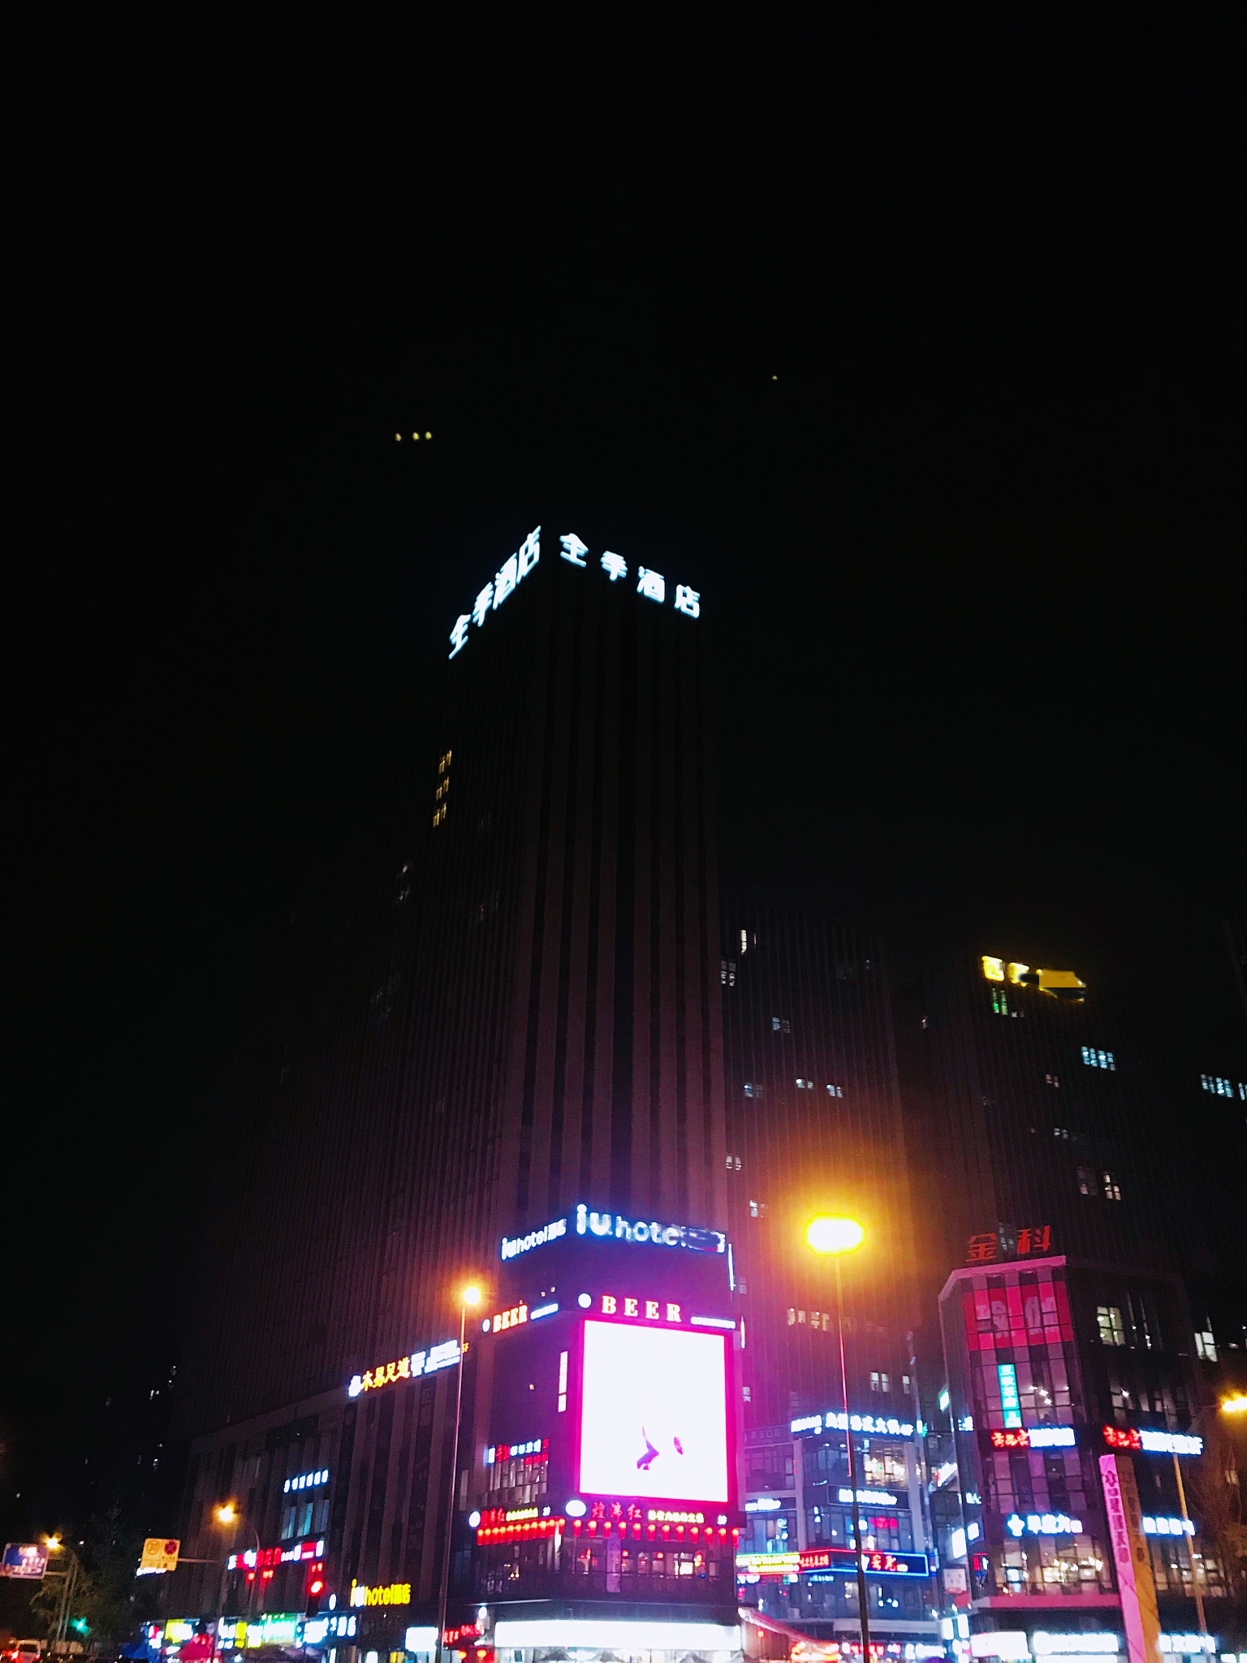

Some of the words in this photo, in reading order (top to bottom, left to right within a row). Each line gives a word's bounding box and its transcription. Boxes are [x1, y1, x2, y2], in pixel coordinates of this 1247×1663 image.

[449, 525, 541, 660] 全季酒店
[559, 533, 701, 618] 全季酒店
[965, 1224, 1051, 1262] 金科
[493, 1304, 528, 1333] BEER
[602, 1295, 682, 1323] BEER
